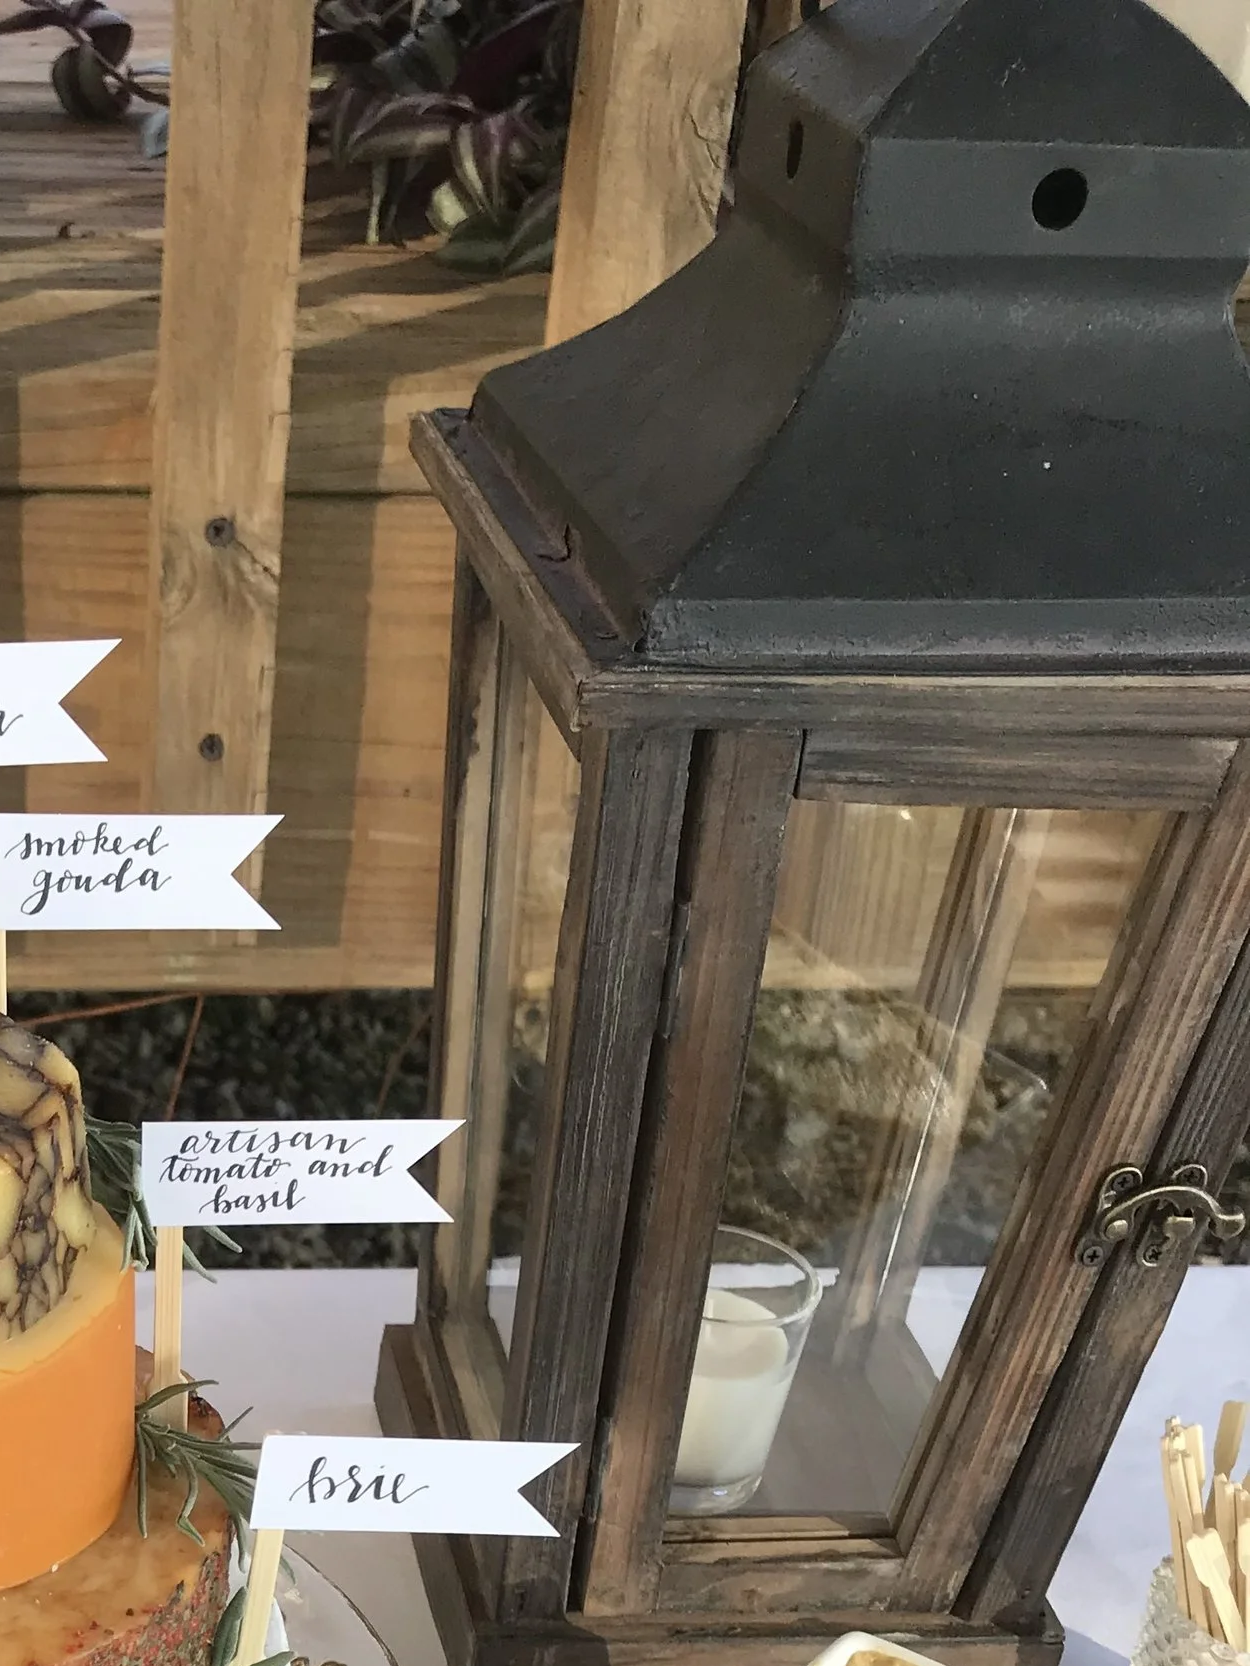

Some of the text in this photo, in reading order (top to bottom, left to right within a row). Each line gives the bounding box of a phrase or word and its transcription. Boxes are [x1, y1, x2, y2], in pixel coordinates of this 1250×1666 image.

[4, 822, 170, 860] smoked
[20, 857, 172, 915] gouda
[179, 1128, 367, 1155] artisan
[158, 1144, 394, 1184] tomato and
[198, 1178, 307, 1214] basil
[288, 1456, 430, 1504] brie
